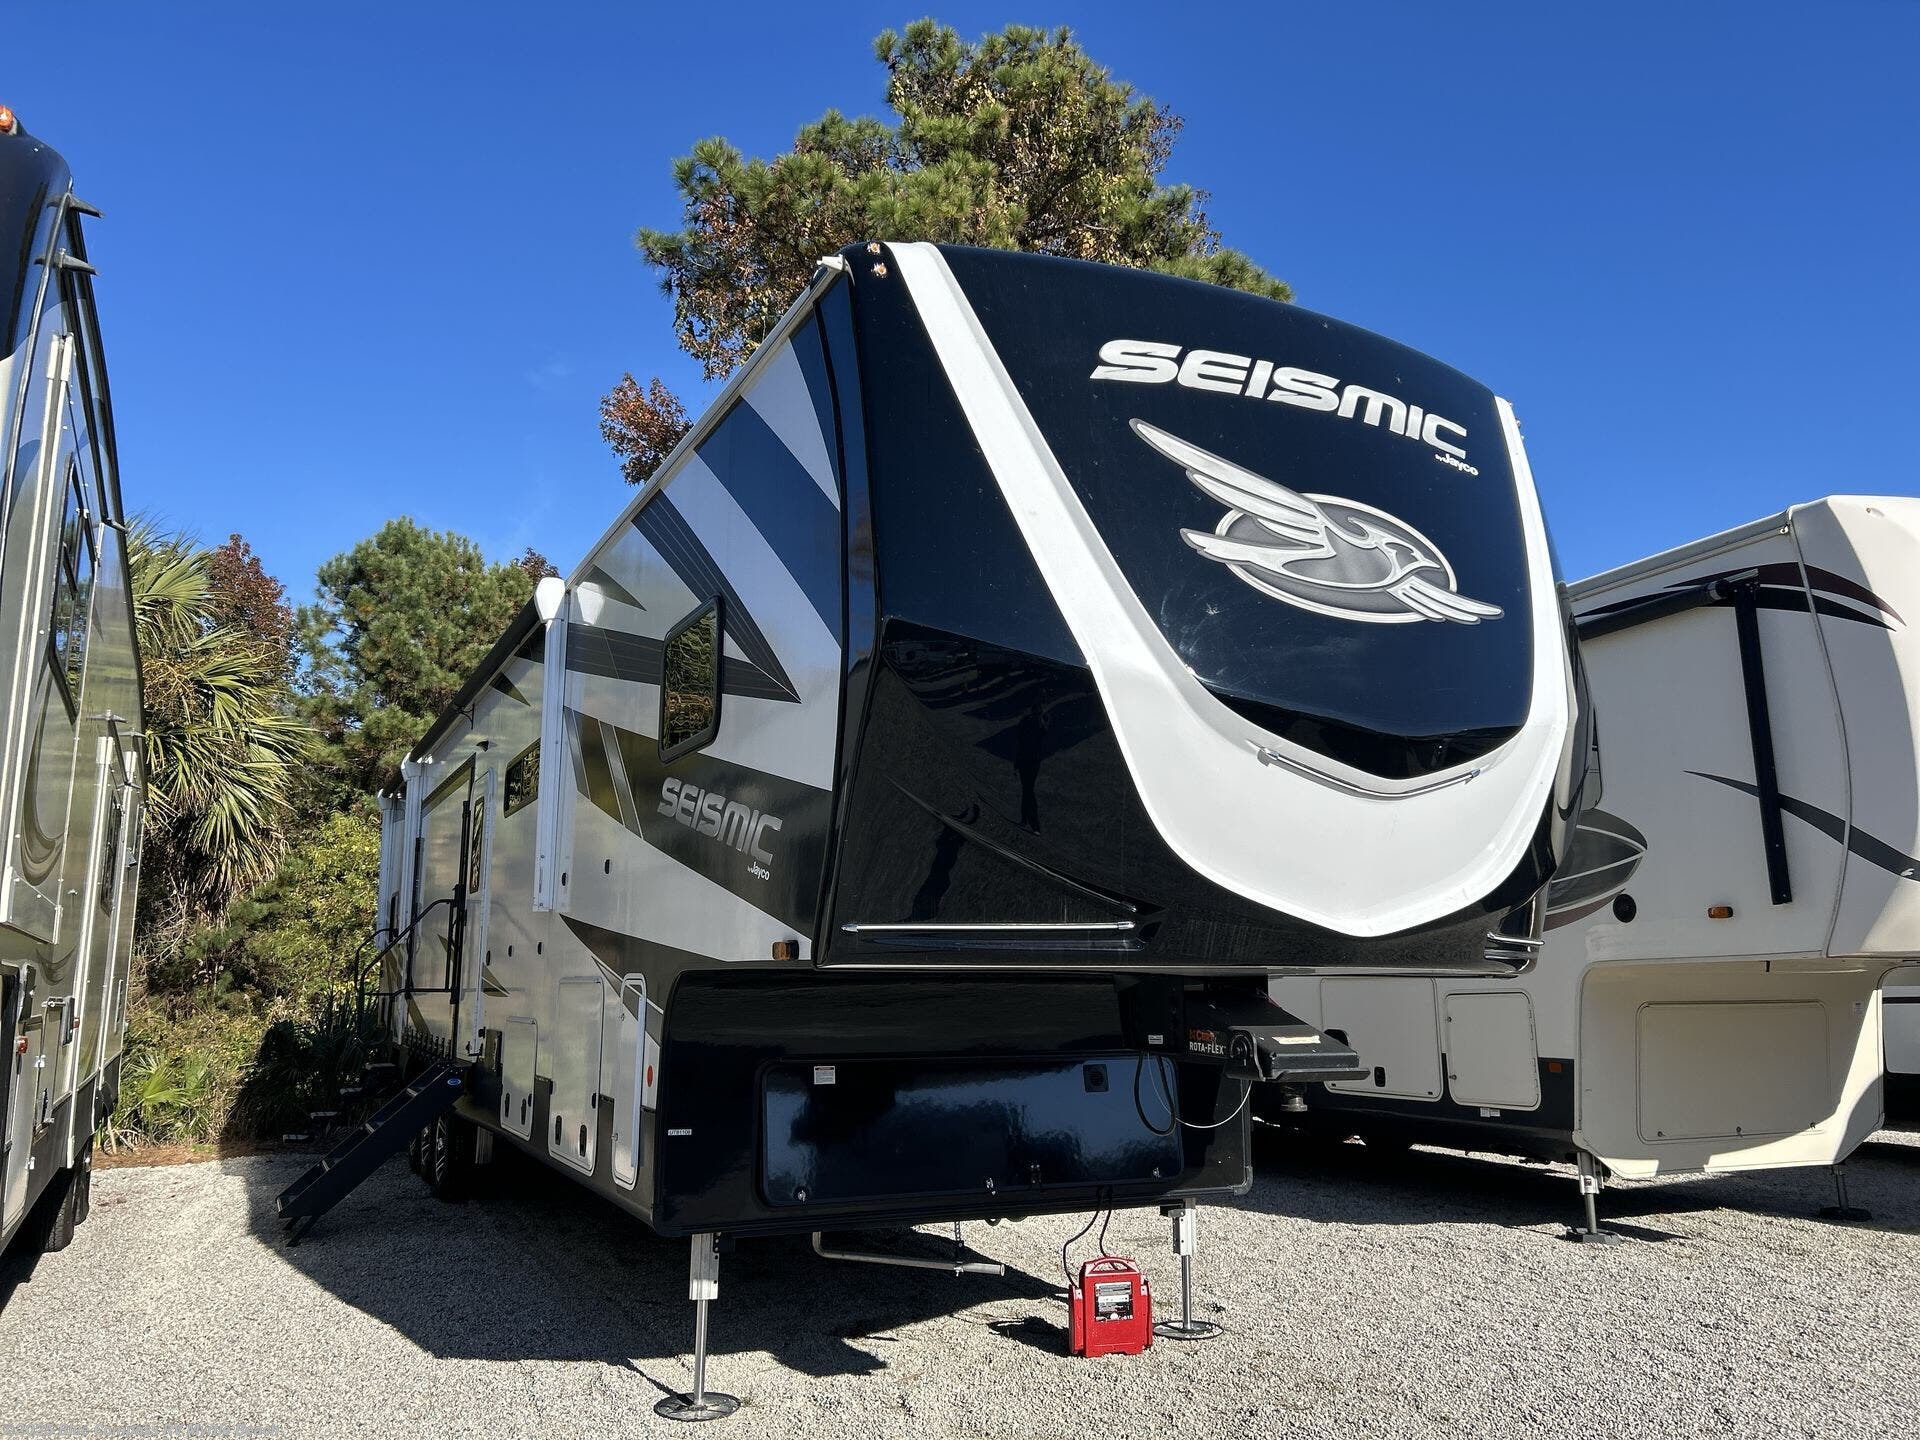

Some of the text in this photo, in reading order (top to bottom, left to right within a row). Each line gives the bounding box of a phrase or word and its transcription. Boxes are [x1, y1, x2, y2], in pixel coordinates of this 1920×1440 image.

[1090, 339, 1467, 458] SEISMIC
[1443, 453, 1479, 476] Jayco
[657, 776, 783, 866] SEISMIC
[750, 861, 770, 879] Jayco
